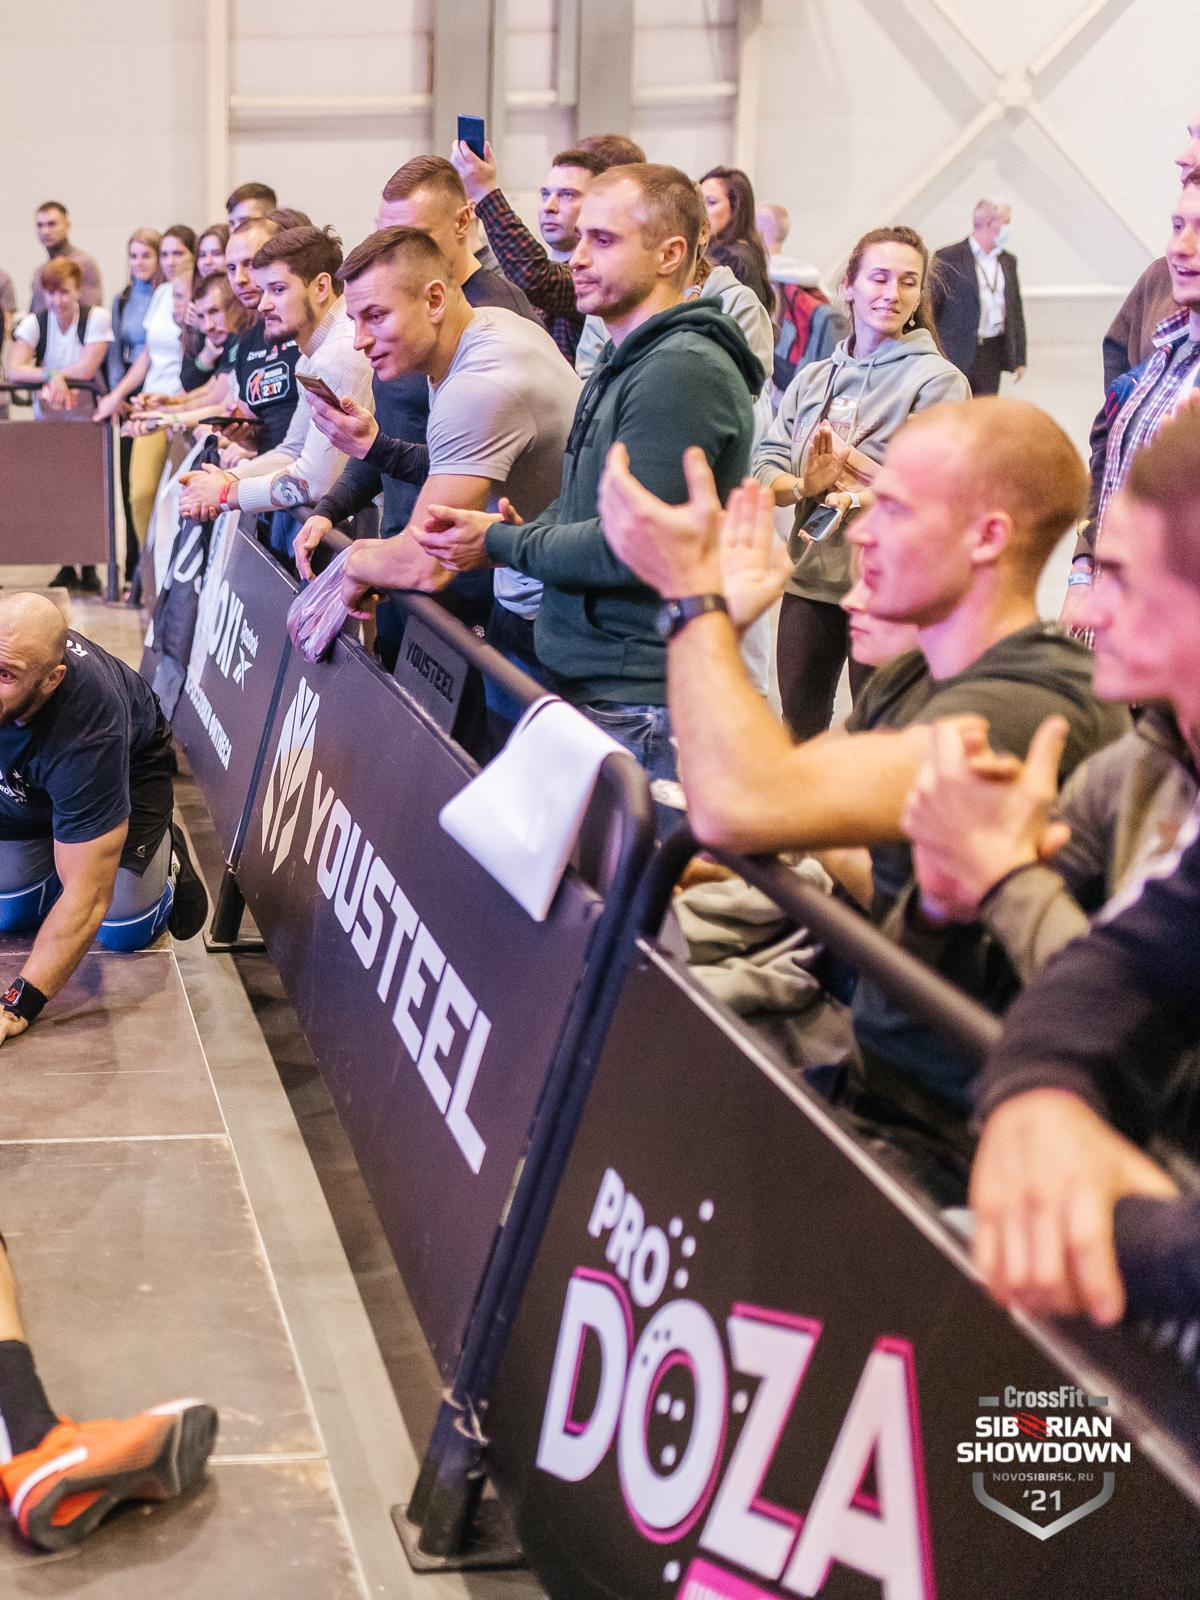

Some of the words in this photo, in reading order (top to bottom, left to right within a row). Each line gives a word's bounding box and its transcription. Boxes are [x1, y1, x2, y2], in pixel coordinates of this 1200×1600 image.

[405, 638, 456, 704] YOUSTEEL
[303, 769, 493, 1175] YOUSTEEL
[587, 1168, 670, 1308] PRO
[536, 1265, 938, 1600] DOZA
